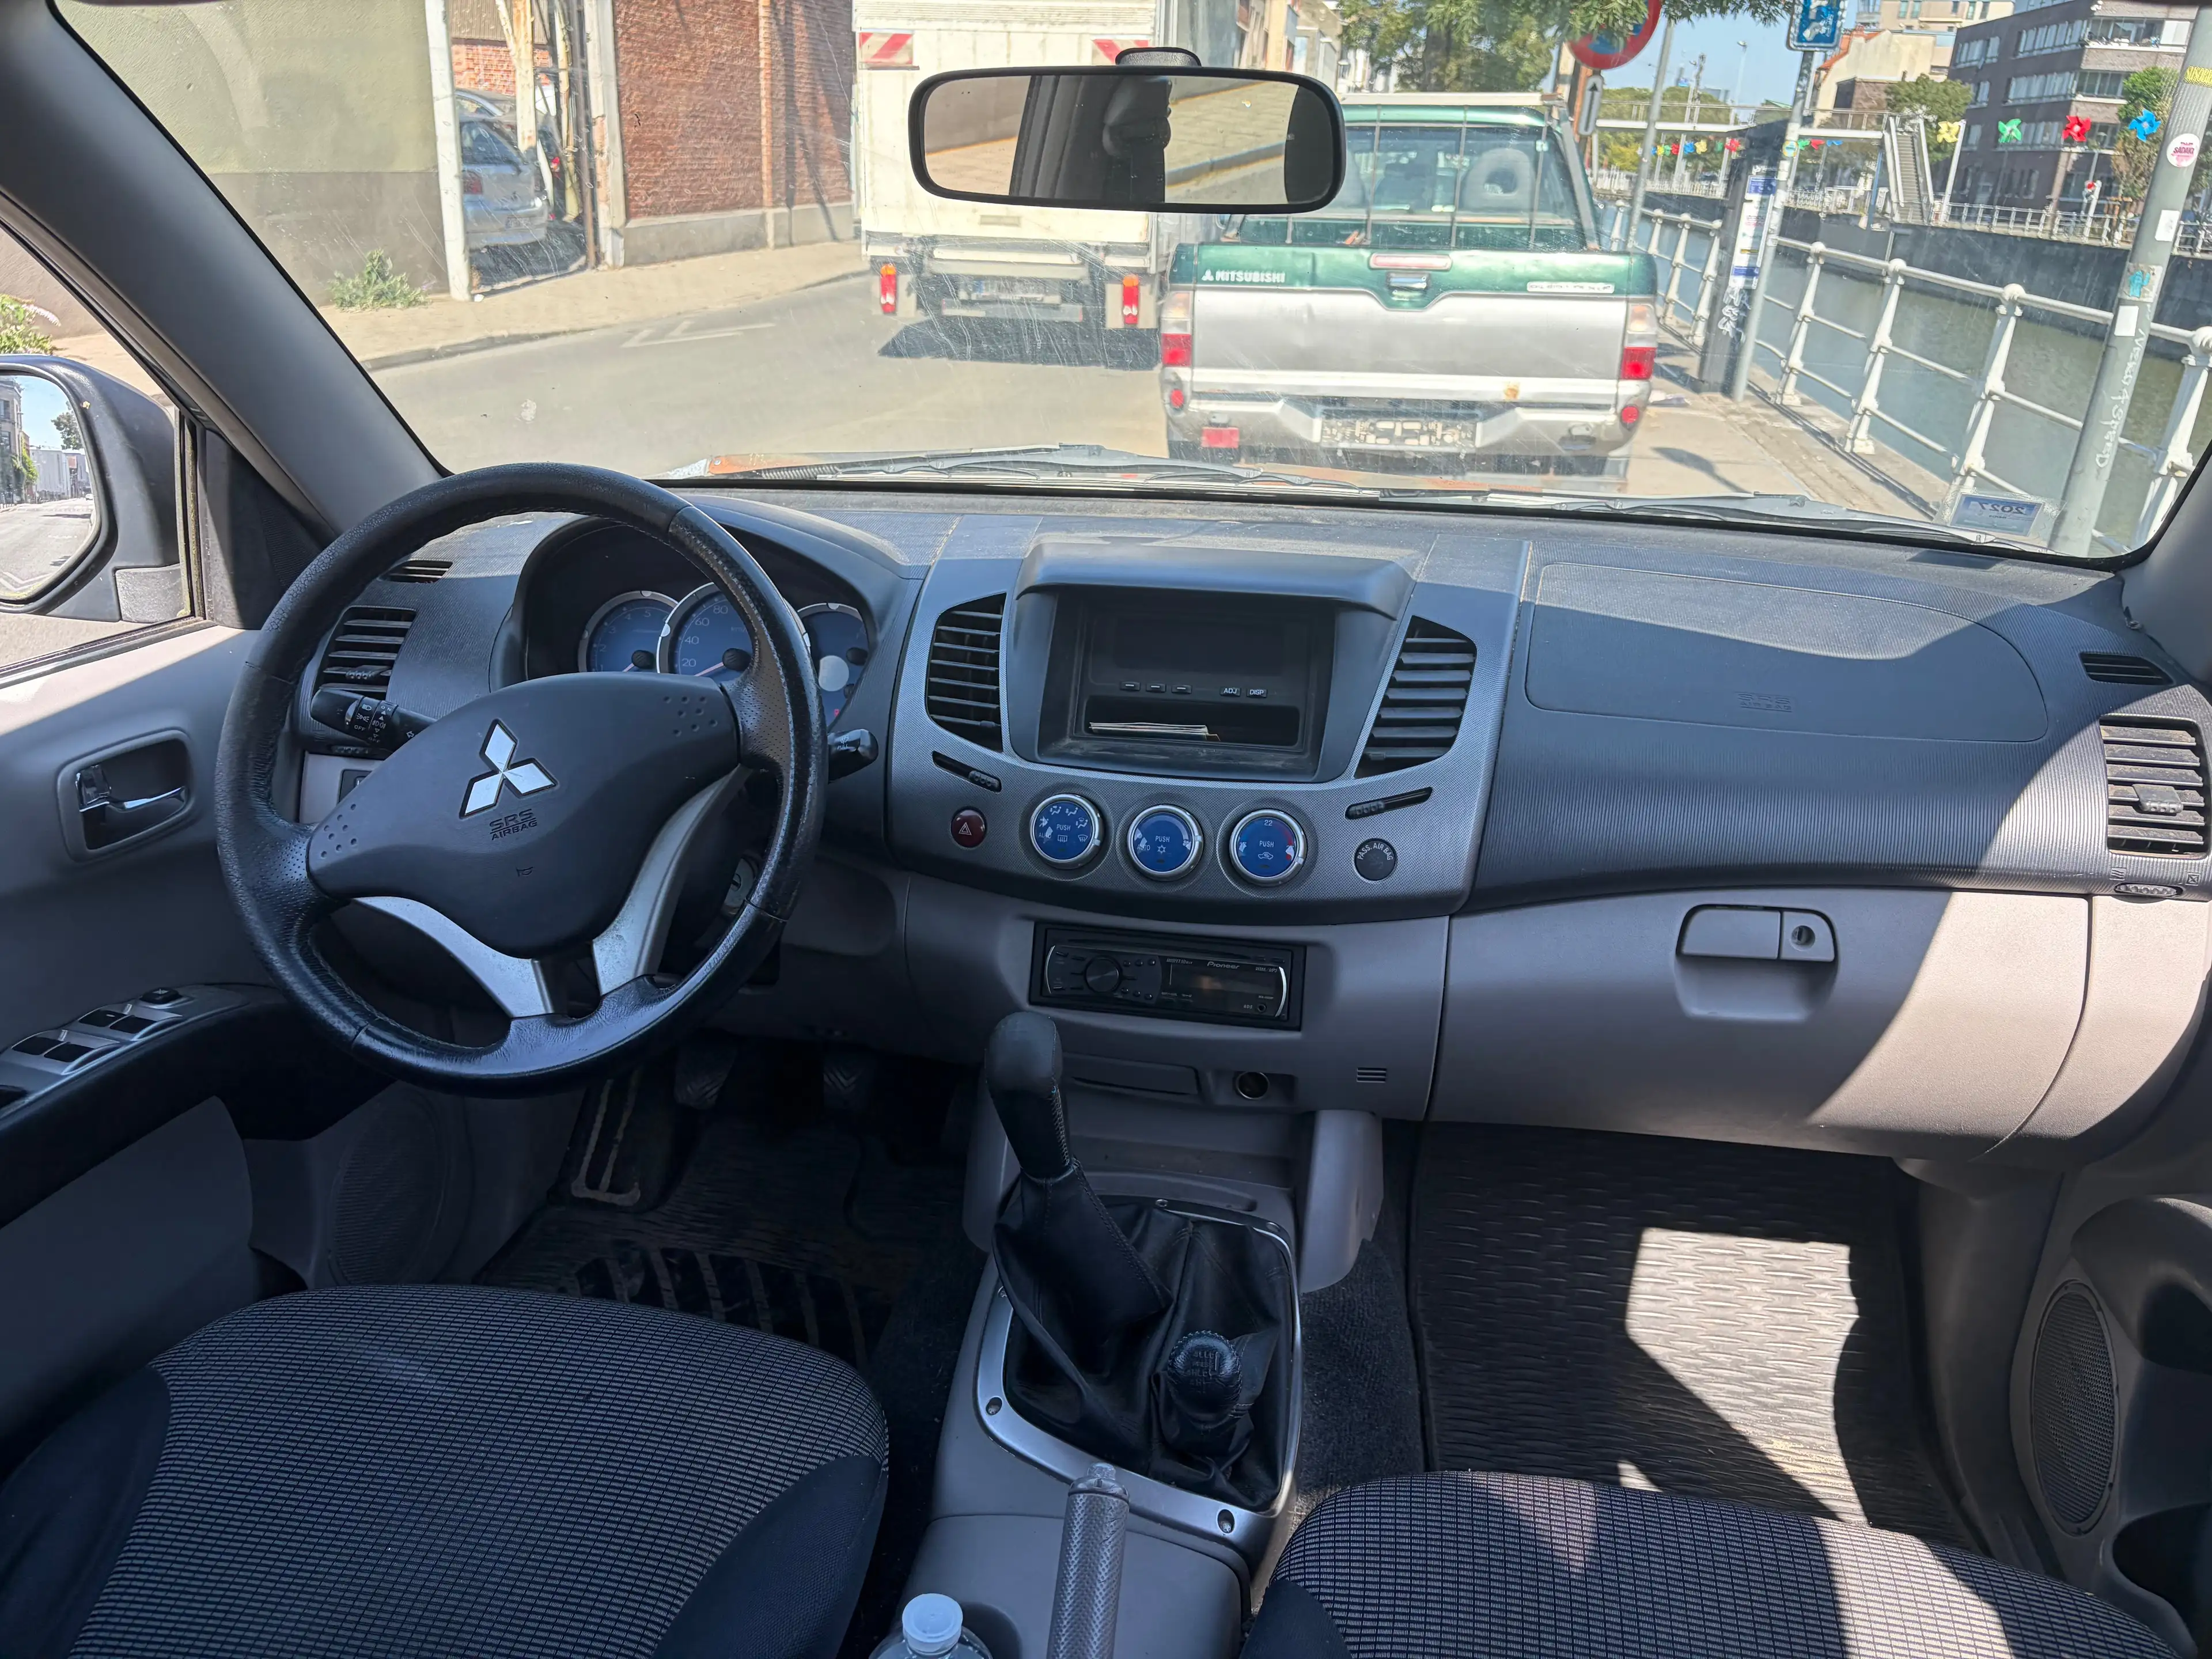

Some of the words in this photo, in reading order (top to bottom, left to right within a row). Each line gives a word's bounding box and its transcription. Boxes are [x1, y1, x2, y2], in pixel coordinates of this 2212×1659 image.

[1215, 270, 1286, 283] MITSUBISHI
[713, 605, 728, 614] 80
[695, 618, 710, 626] 60
[684, 636, 699, 645] 40
[681, 658, 696, 667] 20
[489, 808, 534, 832] SRS
[491, 819, 538, 841] AIRBAG
[1357, 844, 1373, 860] PASS.
[1373, 842, 1384, 851] AIR
[1382, 847, 1394, 861] BAG
[1206, 960, 1240, 969] Pioneer
